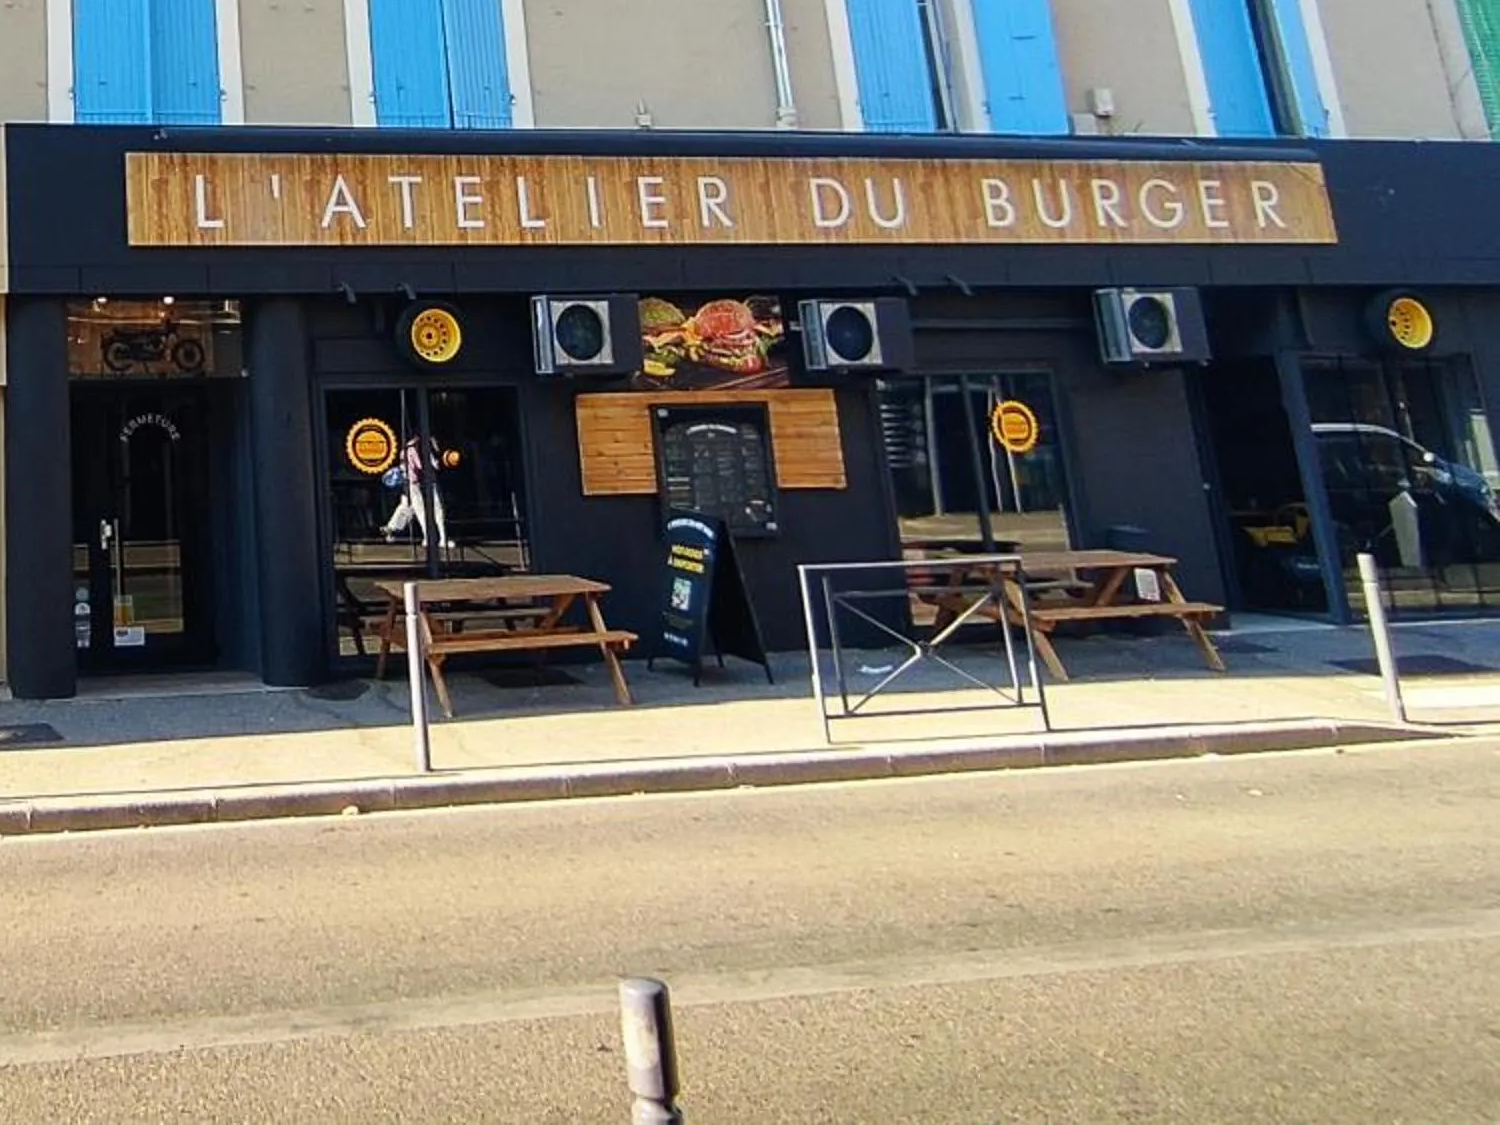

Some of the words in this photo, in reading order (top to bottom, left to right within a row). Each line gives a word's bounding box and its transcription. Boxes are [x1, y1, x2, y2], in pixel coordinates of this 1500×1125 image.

[194, 174, 735, 230] L'ATELIER
[810, 177, 902, 229] DU
[982, 178, 1287, 229] BURGER
